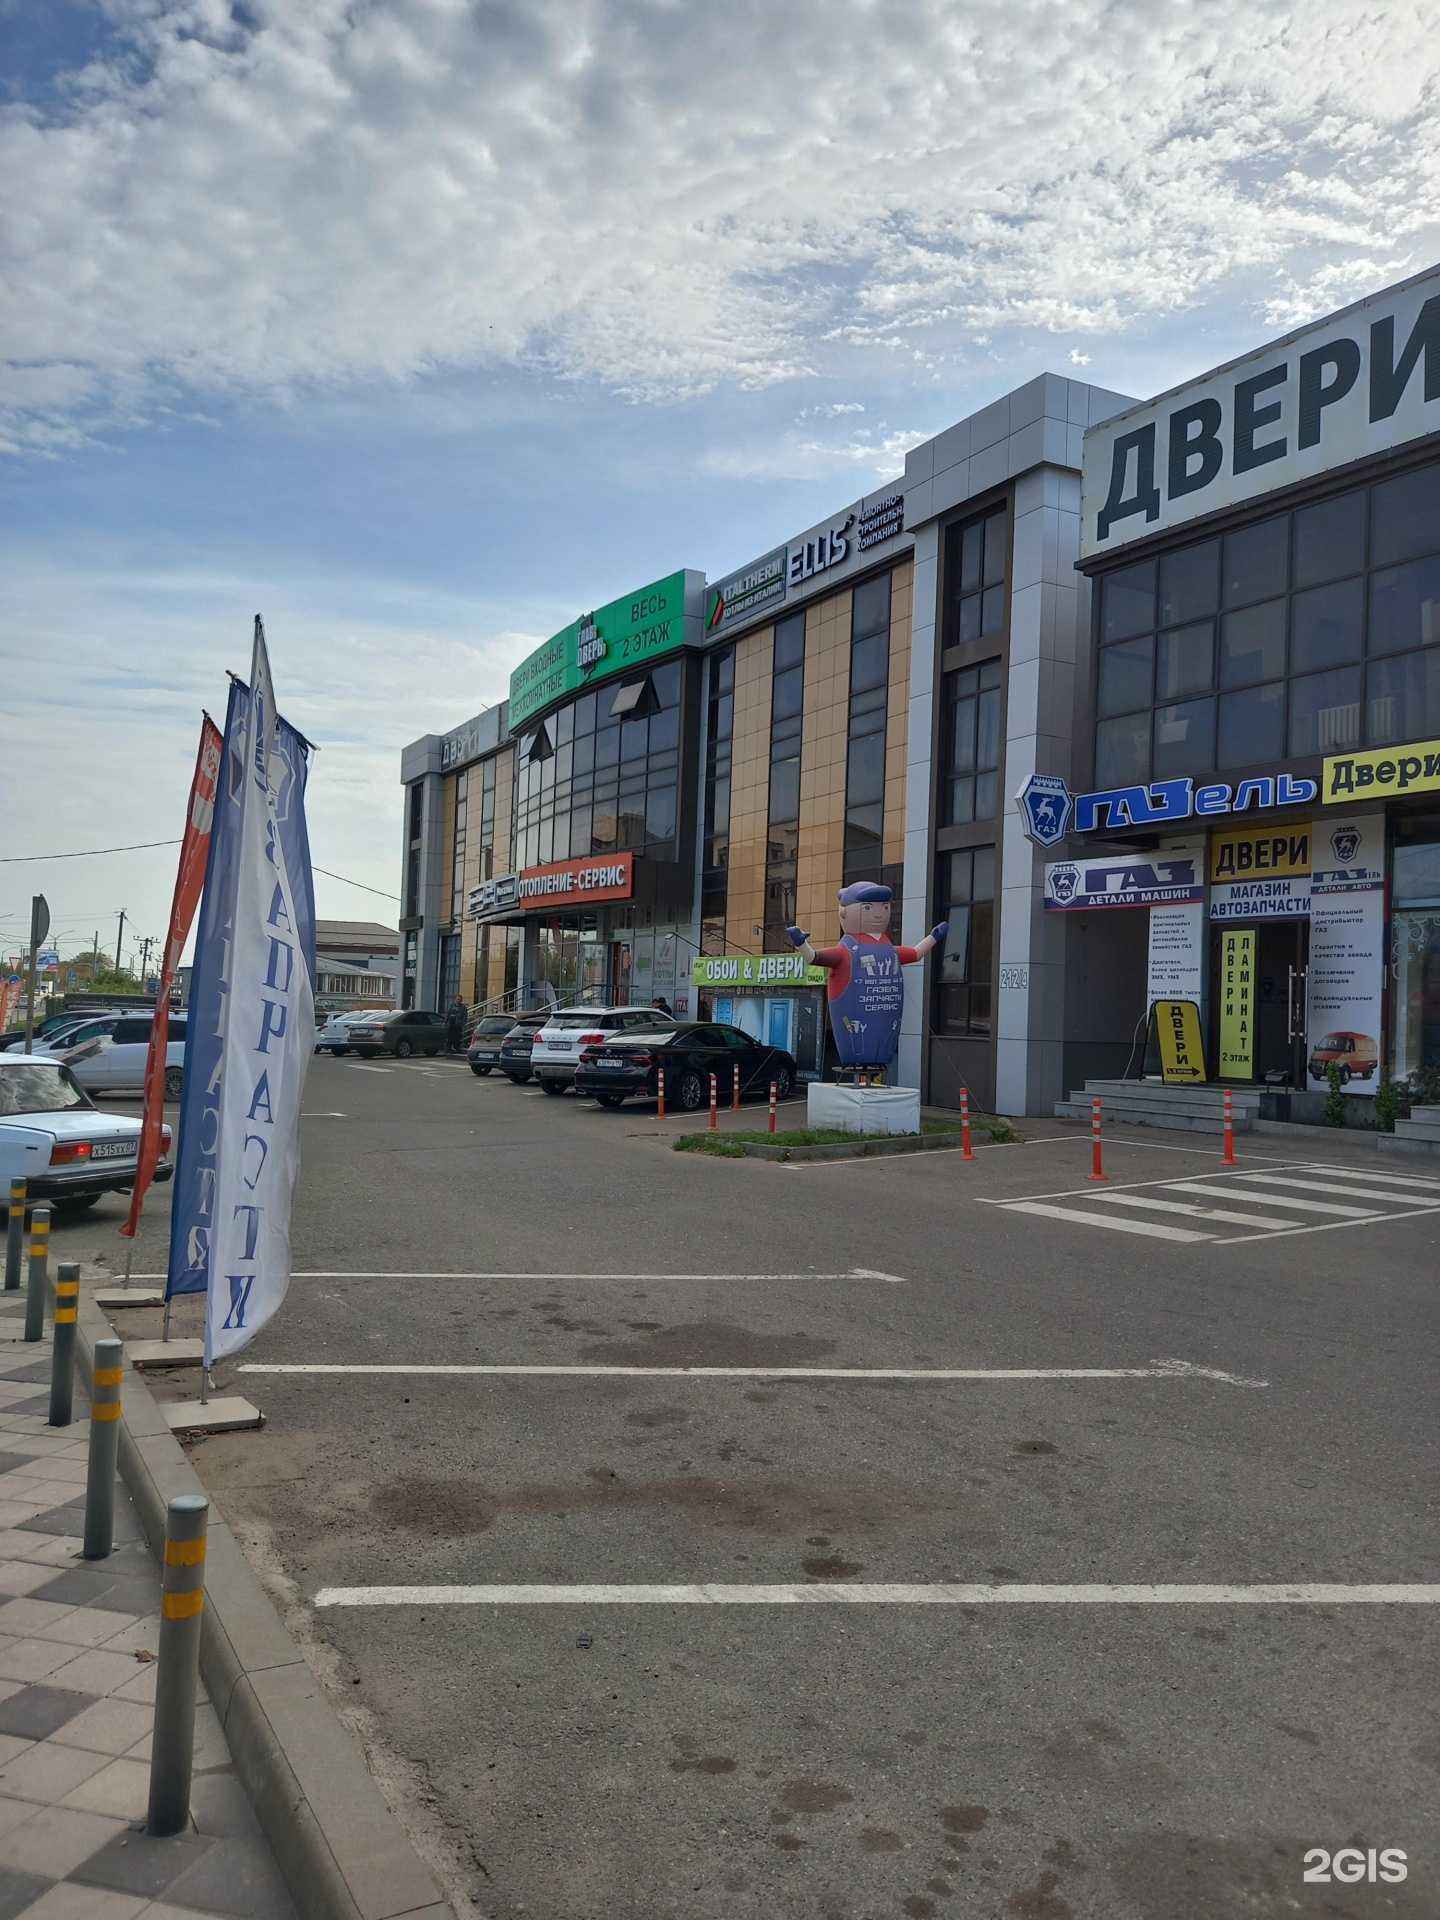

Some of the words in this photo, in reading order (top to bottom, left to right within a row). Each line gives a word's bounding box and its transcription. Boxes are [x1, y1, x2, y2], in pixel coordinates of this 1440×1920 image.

[1097, 296, 1440, 541] ДВЕРИ
[857, 522, 898, 550] КОМПАНИЯ
[631, 592, 667, 623] ВЕСЬ
[622, 638, 630, 657] 2
[633, 622, 671, 651] ЭТАЖ
[1331, 753, 1440, 795] Двери
[1037, 824, 1056, 833] ГАЗ
[1215, 835, 1308, 876] ДВЕРИ
[1085, 860, 1195, 893] ГАЗ
[1230, 882, 1291, 899] МАГАЗИН
[1088, 895, 1134, 905] ДЕТАЛИ
[1141, 888, 1191, 902] МАШИН
[1210, 898, 1312, 917] АВТОЗАПЧАСТИ
[706, 959, 739, 980] ОБОИ
[744, 958, 753, 979] &
[757, 957, 804, 982] ДВЕРИ
[1226, 938, 1235, 1016] ДВЕРИ
[865, 1003, 899, 1012] СЕРВИС
[1240, 938, 1250, 1049] ЛАМИНАТ
[1171, 1006, 1188, 1064] ДВЕРИ
